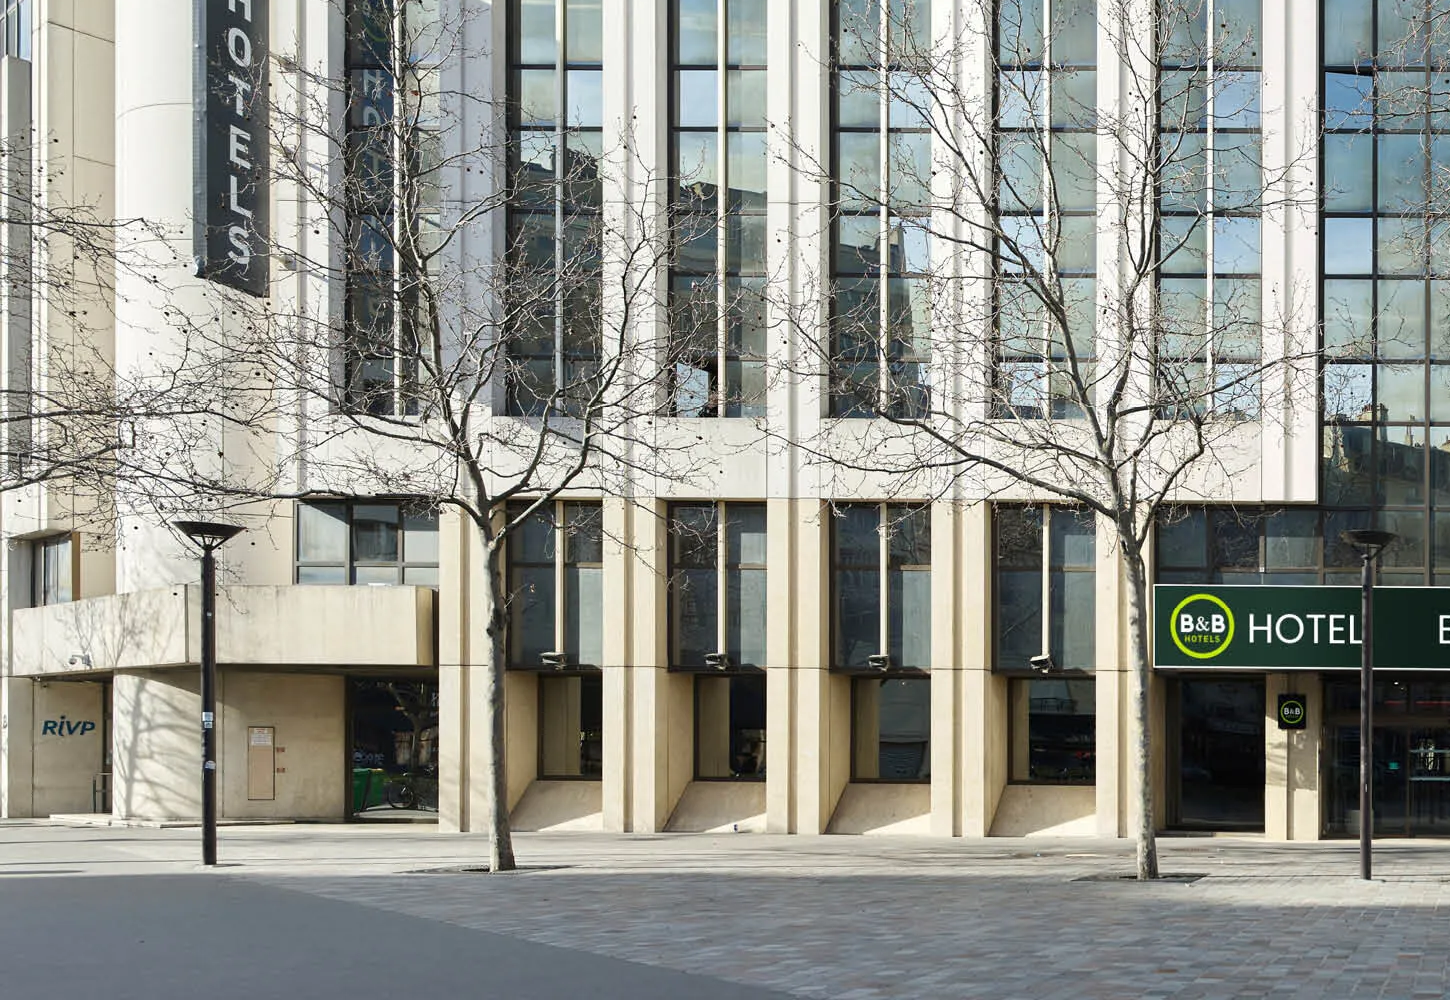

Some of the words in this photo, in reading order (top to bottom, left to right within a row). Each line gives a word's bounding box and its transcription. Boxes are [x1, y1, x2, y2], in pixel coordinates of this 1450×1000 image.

[1180, 614, 1226, 633] B&B
[1248, 613, 1363, 644] HOTEL
[1184, 634, 1221, 643] HOTELS
